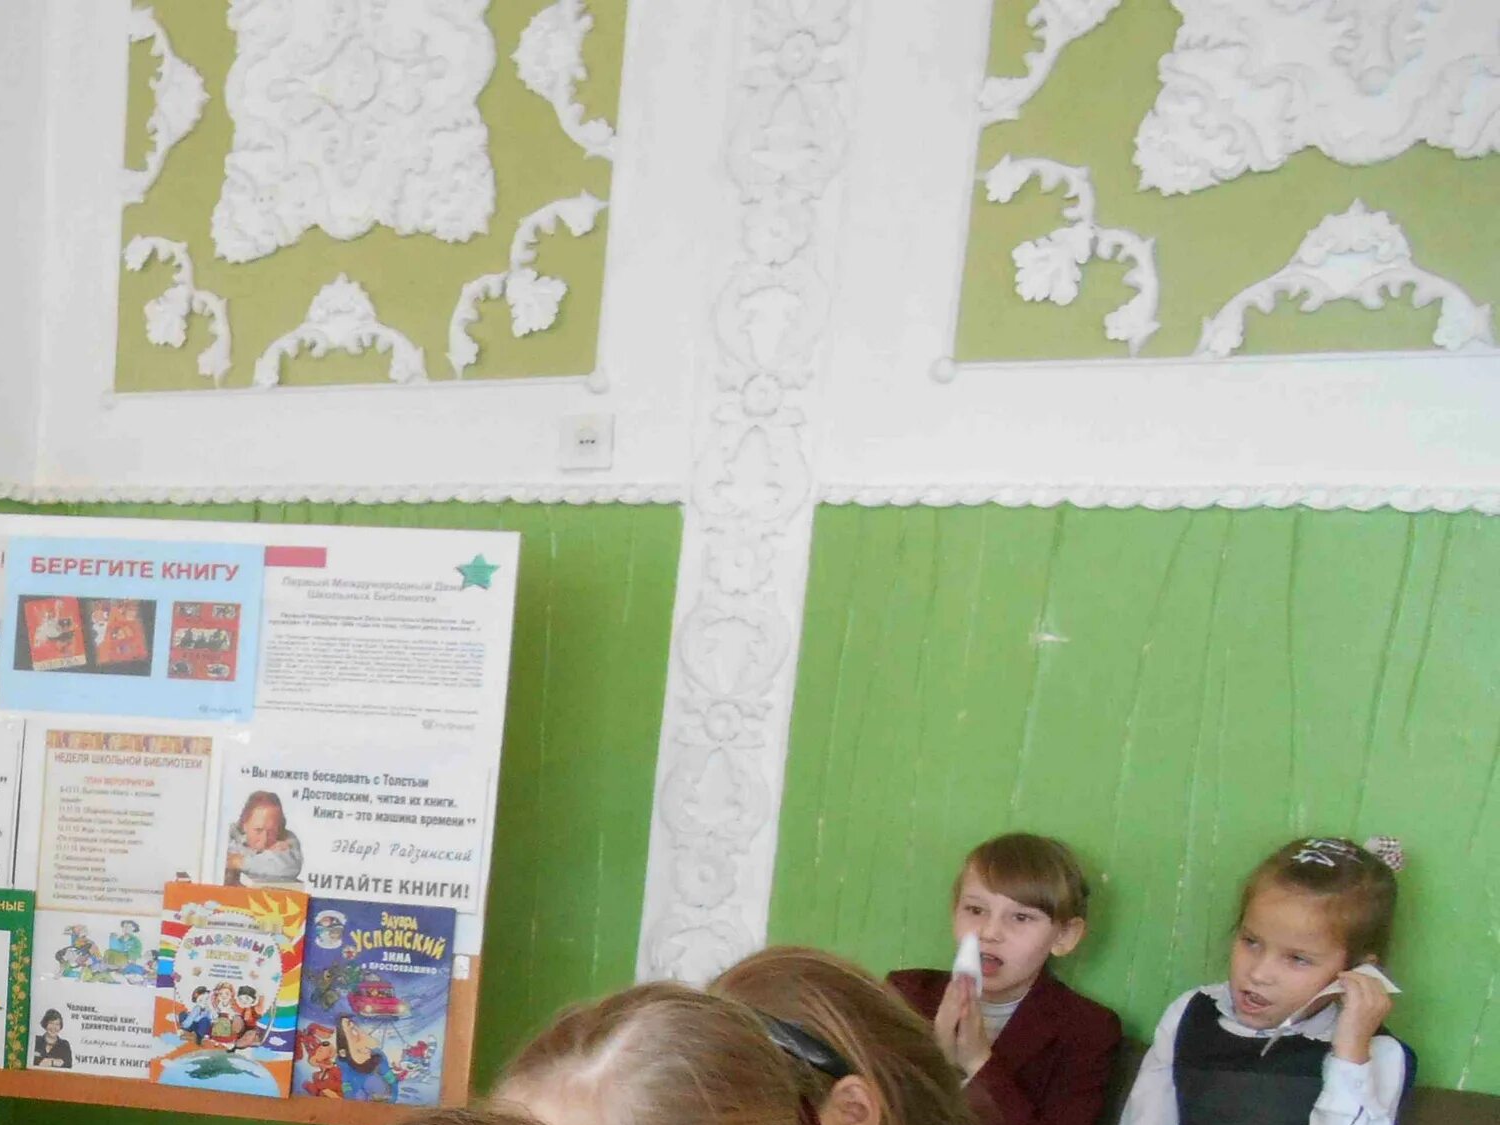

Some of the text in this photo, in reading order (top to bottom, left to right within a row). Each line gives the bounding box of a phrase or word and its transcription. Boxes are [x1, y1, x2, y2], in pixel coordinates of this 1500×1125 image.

[31, 557, 240, 582] БЕРЕГИТЕ КНИГУ
[270, 769, 310, 782] можете
[312, 770, 371, 786] беседовать
[373, 776, 380, 785] с
[382, 774, 430, 788] Толстым
[292, 789, 299, 799] и
[376, 794, 407, 806] читая
[408, 796, 422, 806] их
[312, 806, 344, 820] Книга
[355, 811, 373, 822] это
[375, 812, 418, 824] машина
[307, 872, 470, 899] ЧИТАЙТЕ КНИГИ!
[382, 951, 412, 964] ЗИМА
[75, 1054, 118, 1067] ЧИТАЙТЕ
